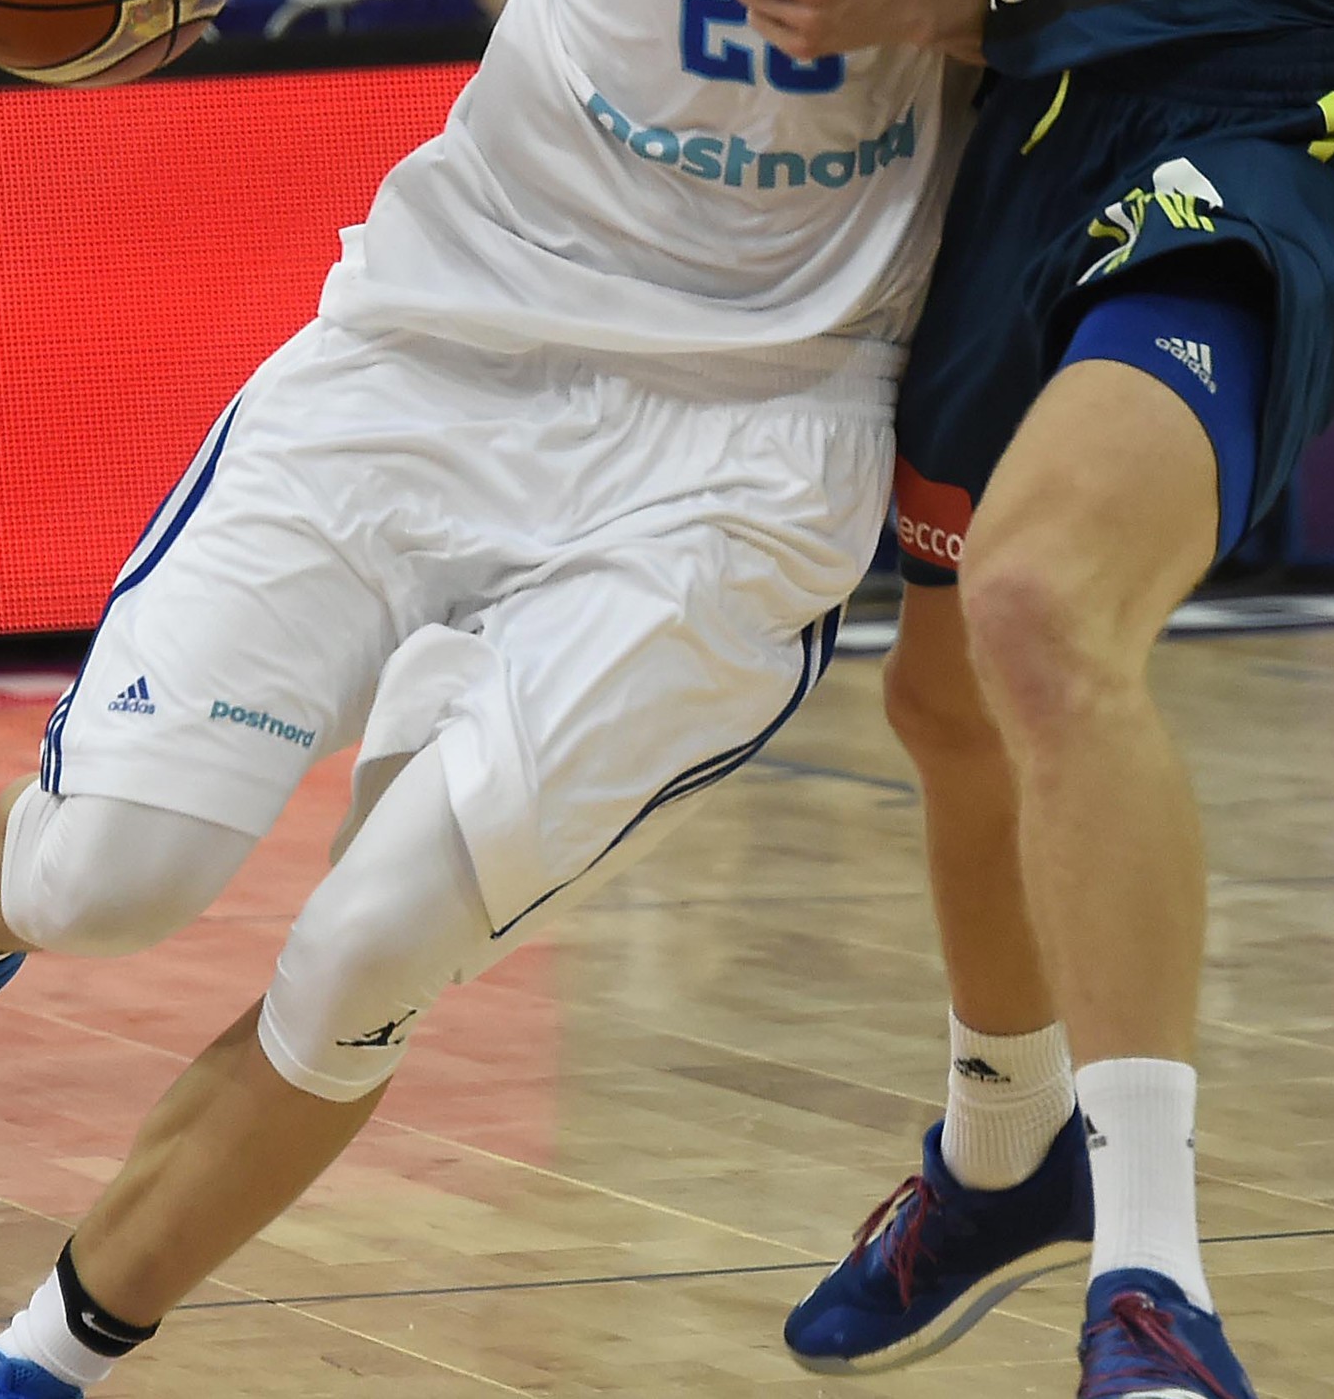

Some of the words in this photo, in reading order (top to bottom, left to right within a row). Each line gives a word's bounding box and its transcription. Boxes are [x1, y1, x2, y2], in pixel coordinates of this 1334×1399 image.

[587, 92, 915, 190] postnord
[898, 516, 965, 561] ecco
[108, 699, 155, 715] adidas
[210, 699, 316, 749] postnord
